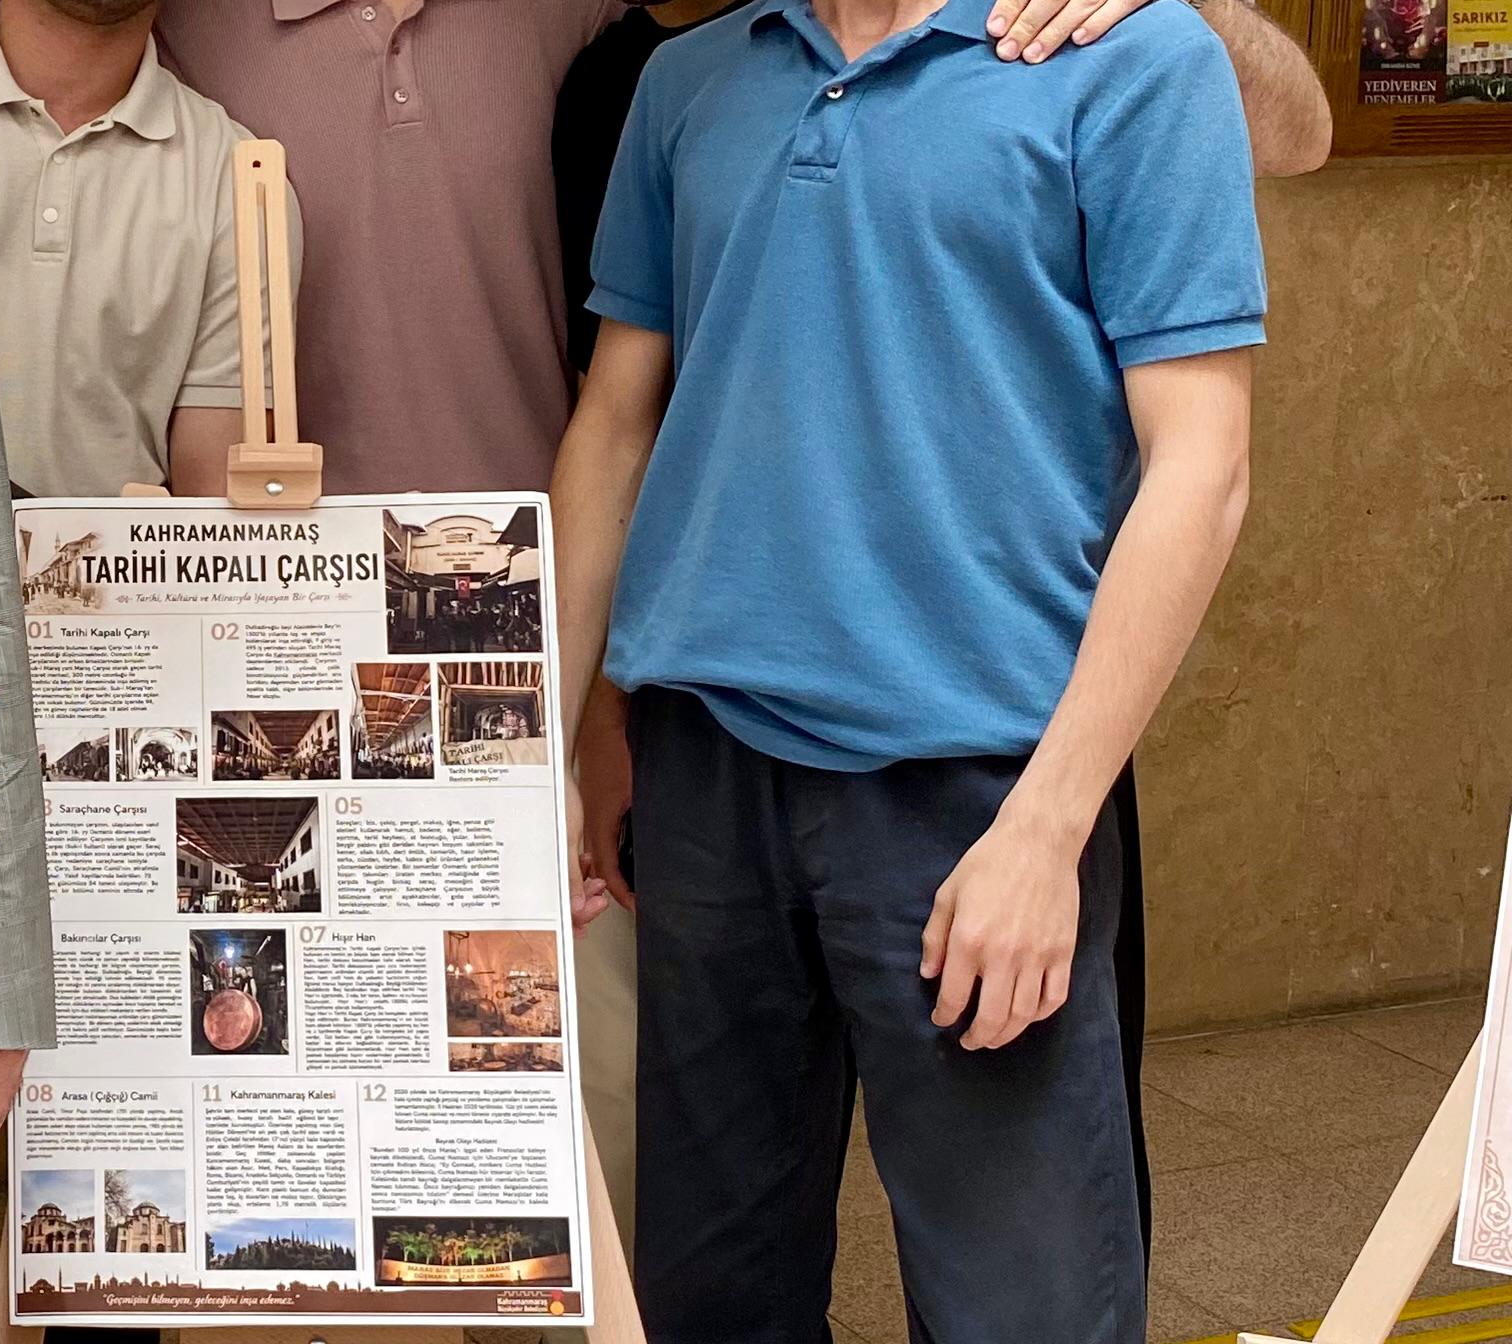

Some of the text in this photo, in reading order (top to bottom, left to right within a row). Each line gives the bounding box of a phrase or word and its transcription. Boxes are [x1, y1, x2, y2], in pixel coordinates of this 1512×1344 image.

[1453, 12, 1508, 24] SARIKIZ
[1364, 80, 1437, 92] YEDİVEREN
[130, 523, 319, 545] KAHRAMANMARAŞ
[82, 549, 378, 588] TARİHİ KAPALI ÇARŞISI
[164, 593, 198, 602] Kültürü
[292, 593, 307, 601] Bir
[28, 621, 150, 639] 01 Tarihi Kapalı Çarşı
[211, 623, 239, 640] 02
[449, 743, 485, 757] TARİHİ
[59, 804, 147, 816] Saraçhane Çarşısı
[335, 796, 363, 815] 05
[110, 933, 141, 944] Çarşısı
[299, 926, 376, 943] 07 Hışır Han
[26, 1084, 53, 1103] 08
[61, 1092, 88, 1101] Arasa
[202, 1084, 336, 1102] 11 Kahramanmaraş Kalesi
[363, 1083, 387, 1102] 12
[194, 1294, 238, 1308] geleceğini
[240, 1295, 258, 1306] inşa
